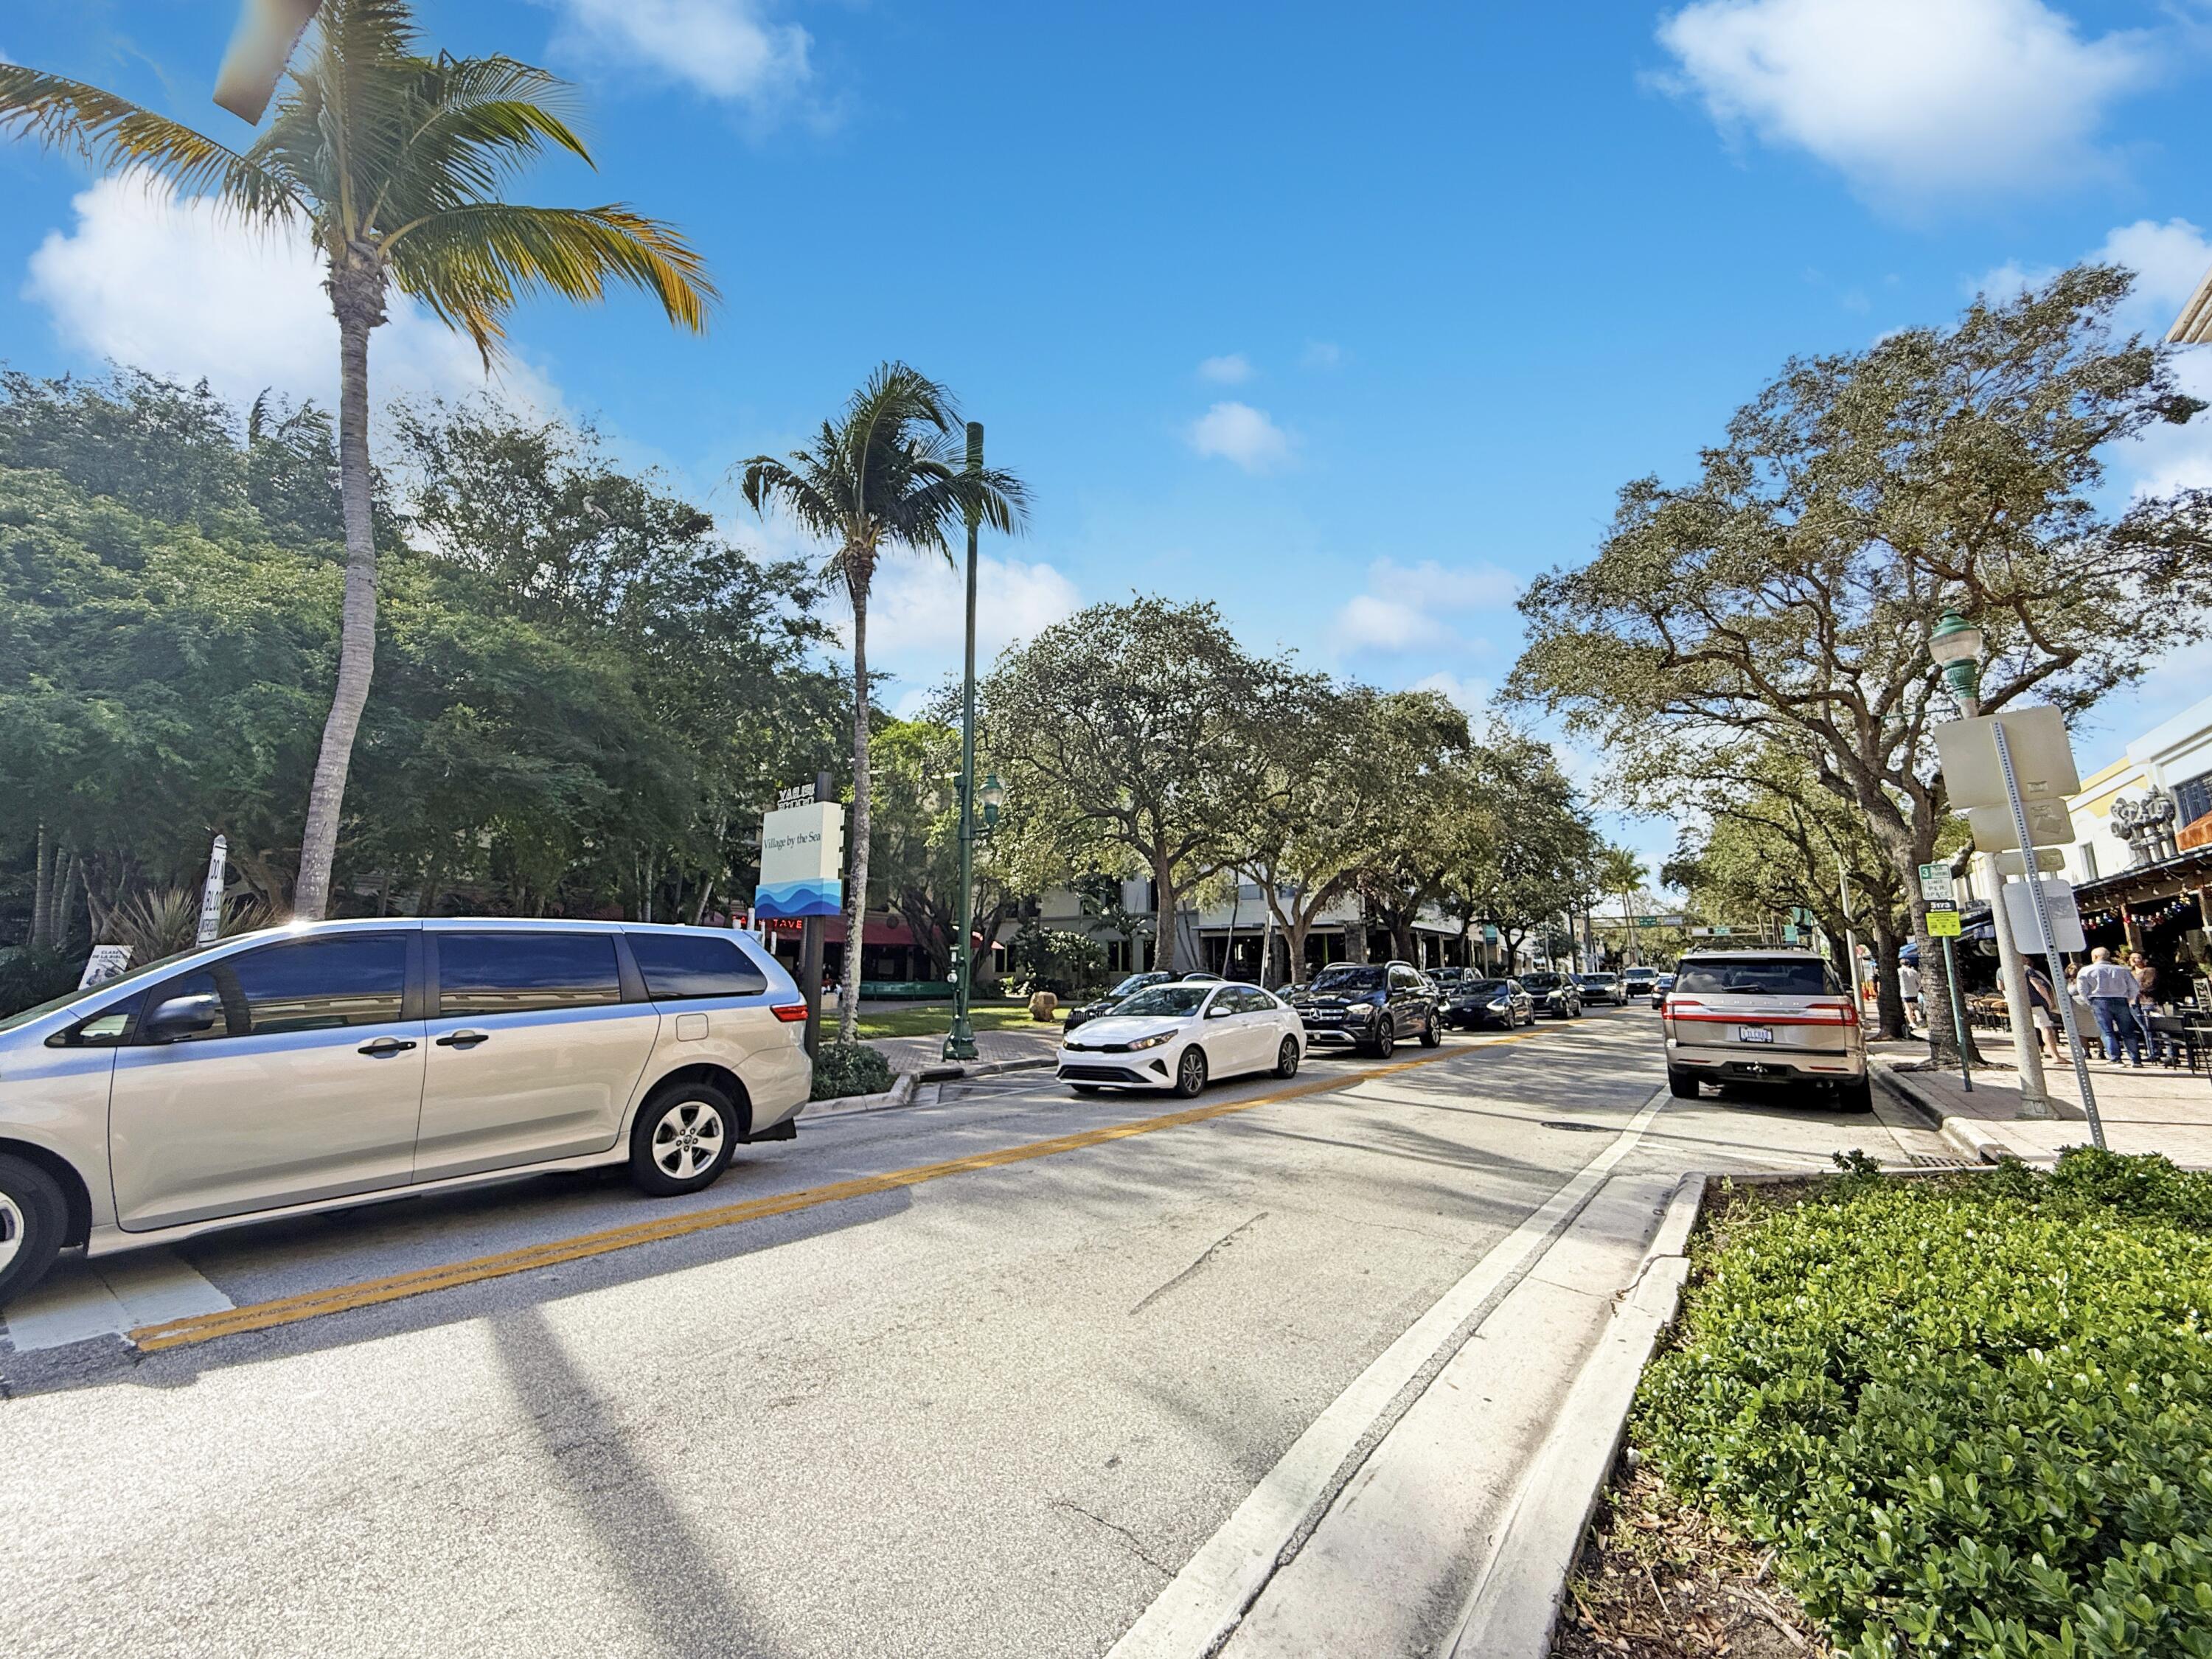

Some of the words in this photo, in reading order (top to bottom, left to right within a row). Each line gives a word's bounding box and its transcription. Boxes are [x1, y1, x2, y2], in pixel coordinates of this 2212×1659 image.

[764, 837, 786, 850] Village
[787, 835, 796, 849] by
[797, 832, 808, 844] the
[808, 831, 821, 842] Sea
[1922, 868, 1929, 877] 3
[773, 919, 802, 929] TAVE
